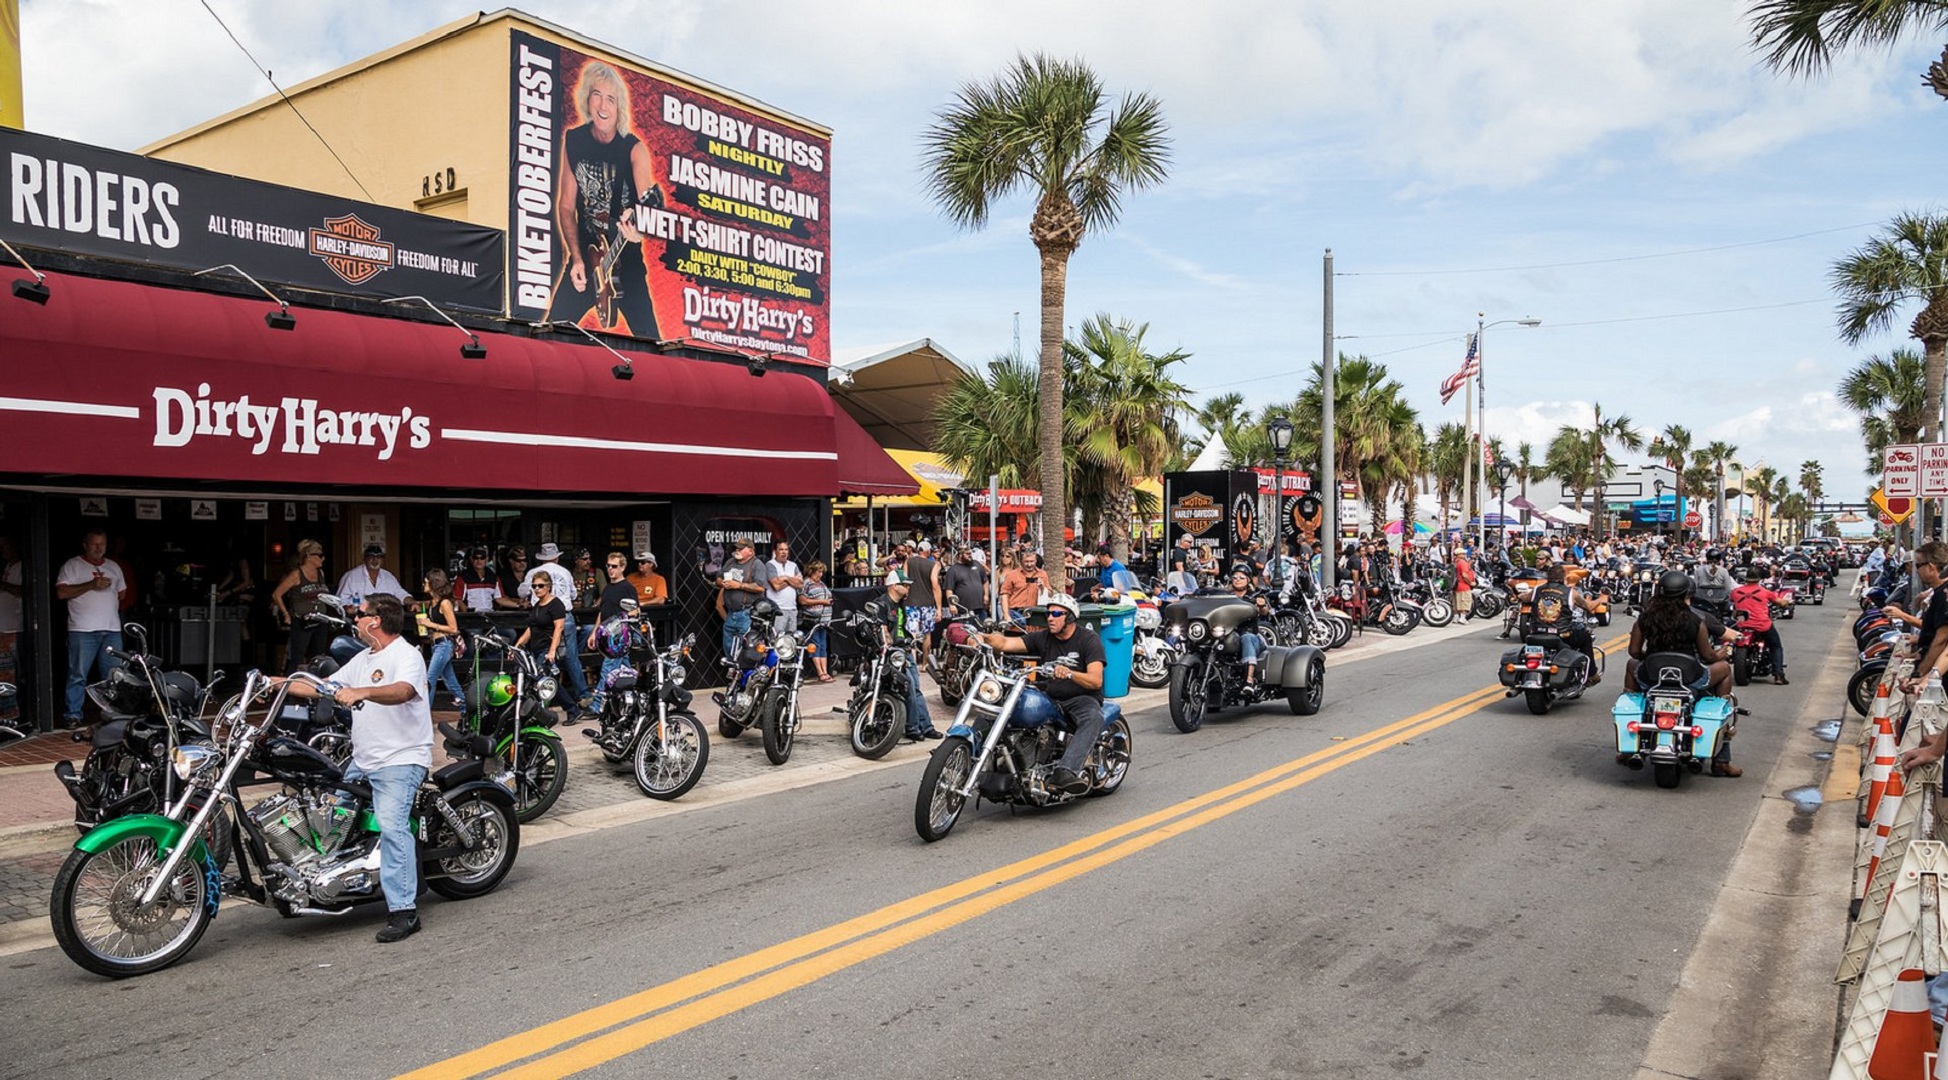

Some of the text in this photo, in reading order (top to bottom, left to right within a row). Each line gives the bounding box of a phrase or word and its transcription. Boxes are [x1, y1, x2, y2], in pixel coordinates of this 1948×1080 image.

[663, 94, 824, 172] BOBBY FRISS
[708, 141, 784, 176] NIGHTLY
[517, 44, 553, 310] BIKETOBERFEST
[669, 154, 820, 222] JASMINE CAIN
[11, 152, 180, 249] RIDERS
[697, 193, 794, 230] SATURDAY
[208, 214, 305, 249] ALL FOR FREEDOM
[333, 221, 375, 240] MOTOR
[635, 203, 824, 275] WET T-SHIRT CONTEST
[316, 235, 389, 262] HARLEY-DAVIDSON
[690, 248, 719, 266] DAILY
[719, 254, 747, 270] WITH
[334, 258, 372, 279] CYCLES
[397, 249, 440, 272] FREEDOM
[441, 257, 459, 275] FOR
[677, 258, 812, 299] 2:00, 3:30, 5:00 and 6:30pm
[1922, 459, 1948, 469] PARKIN
[1931, 447, 1945, 458] NO
[1885, 465, 1917, 473] PARKING
[1891, 477, 1909, 485] ONLY
[1184, 496, 1208, 506] MOTOR
[705, 530, 725, 543] OPEN
[753, 531, 772, 544] DAILY
